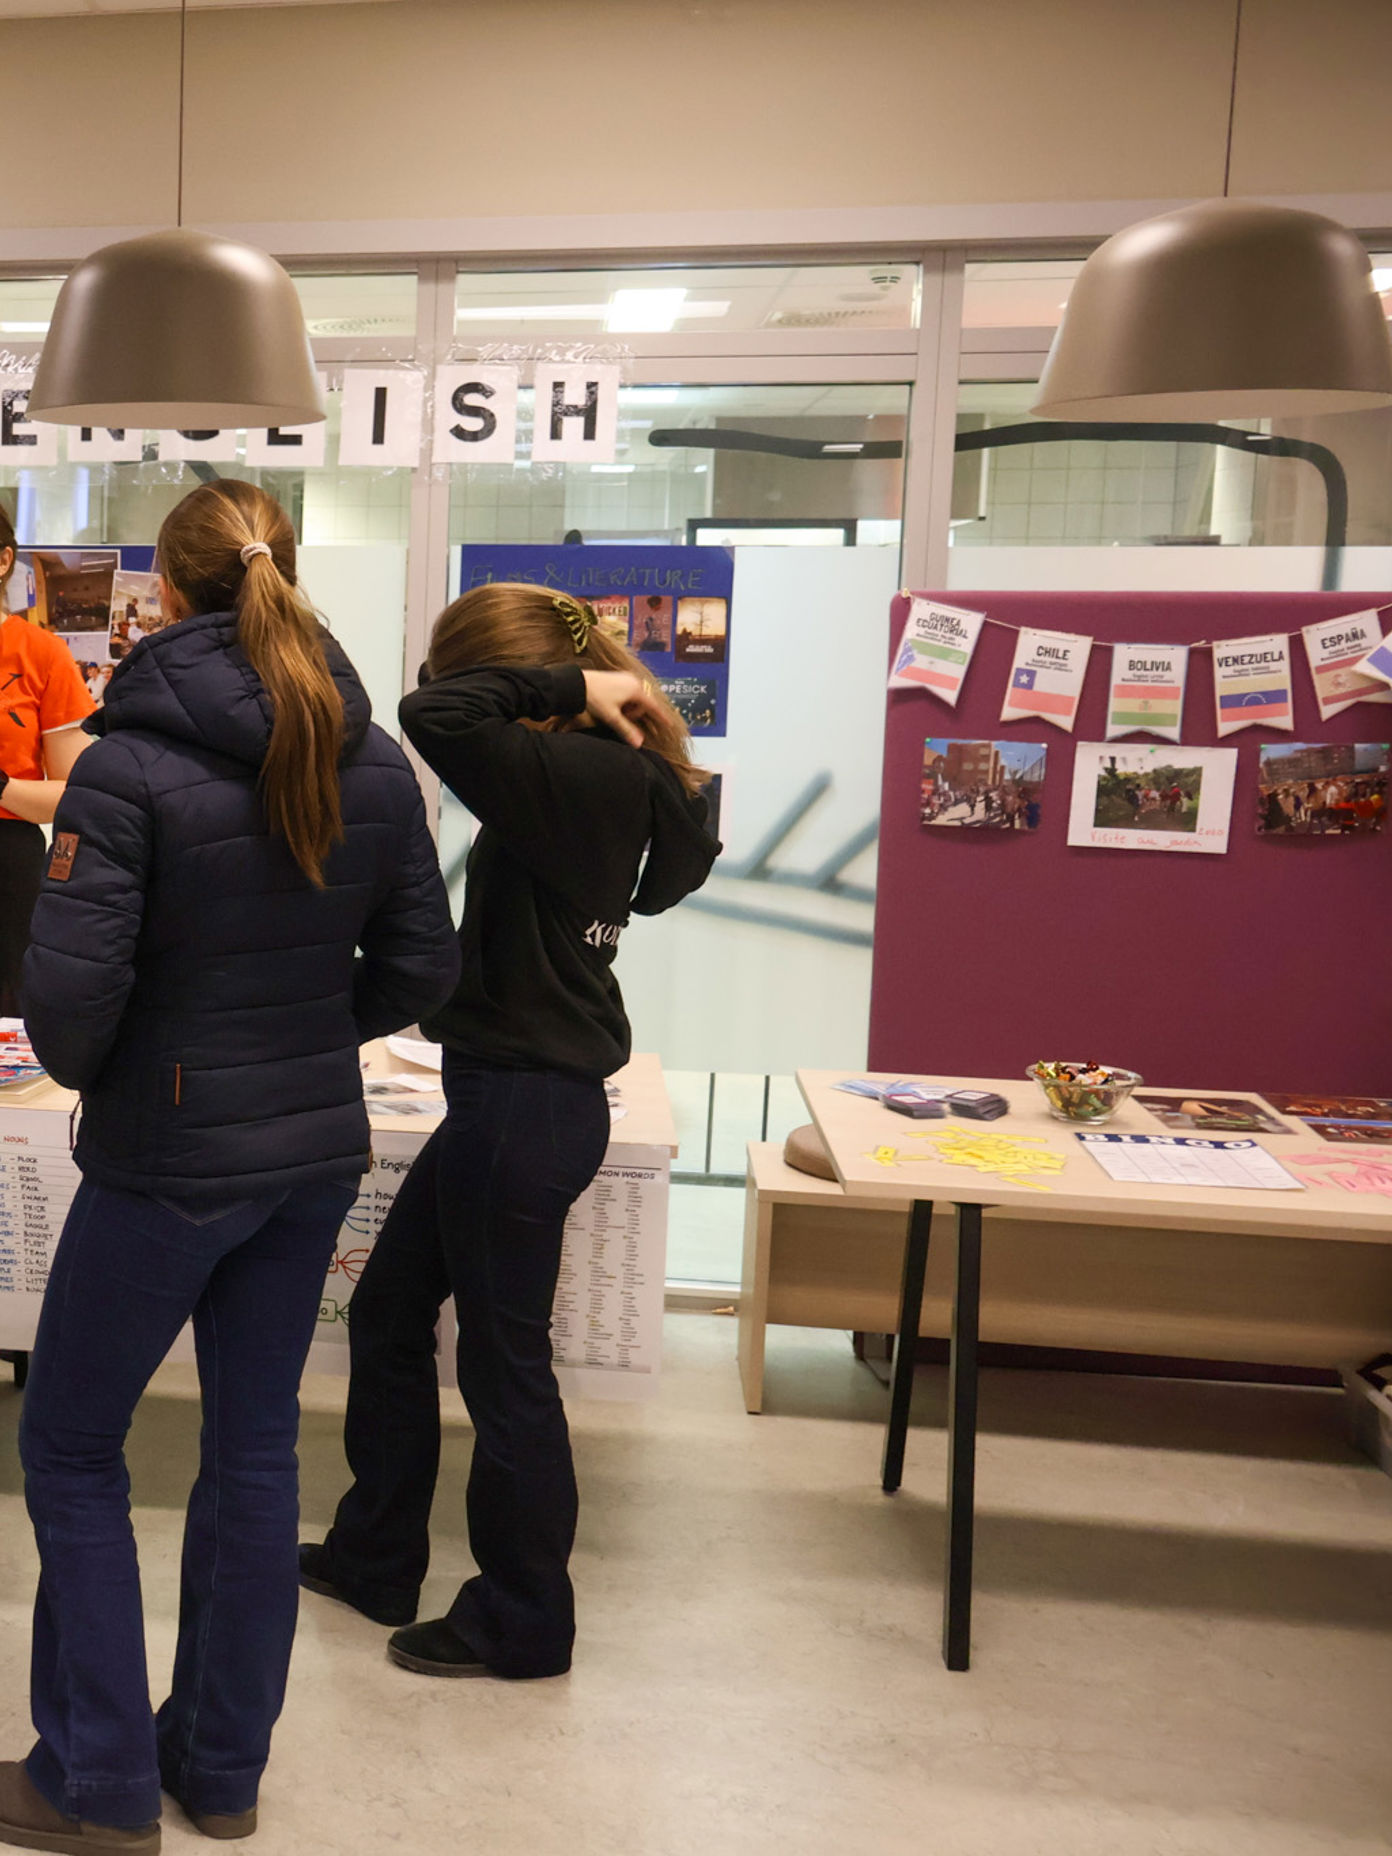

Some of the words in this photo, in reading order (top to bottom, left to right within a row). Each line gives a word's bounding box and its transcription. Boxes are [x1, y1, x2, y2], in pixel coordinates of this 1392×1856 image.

[928, 611, 962, 626] GUINEA
[915, 617, 969, 639] ECUATORIAL
[1320, 627, 1367, 649] ESPAÑA
[1036, 645, 1071, 661] CHILE
[1216, 649, 1285, 668] VENEZUELA
[1128, 660, 1172, 672] BOLIVIA
[1083, 1133, 1254, 1150] BINGO
[381, 1159, 412, 1174] Englis
